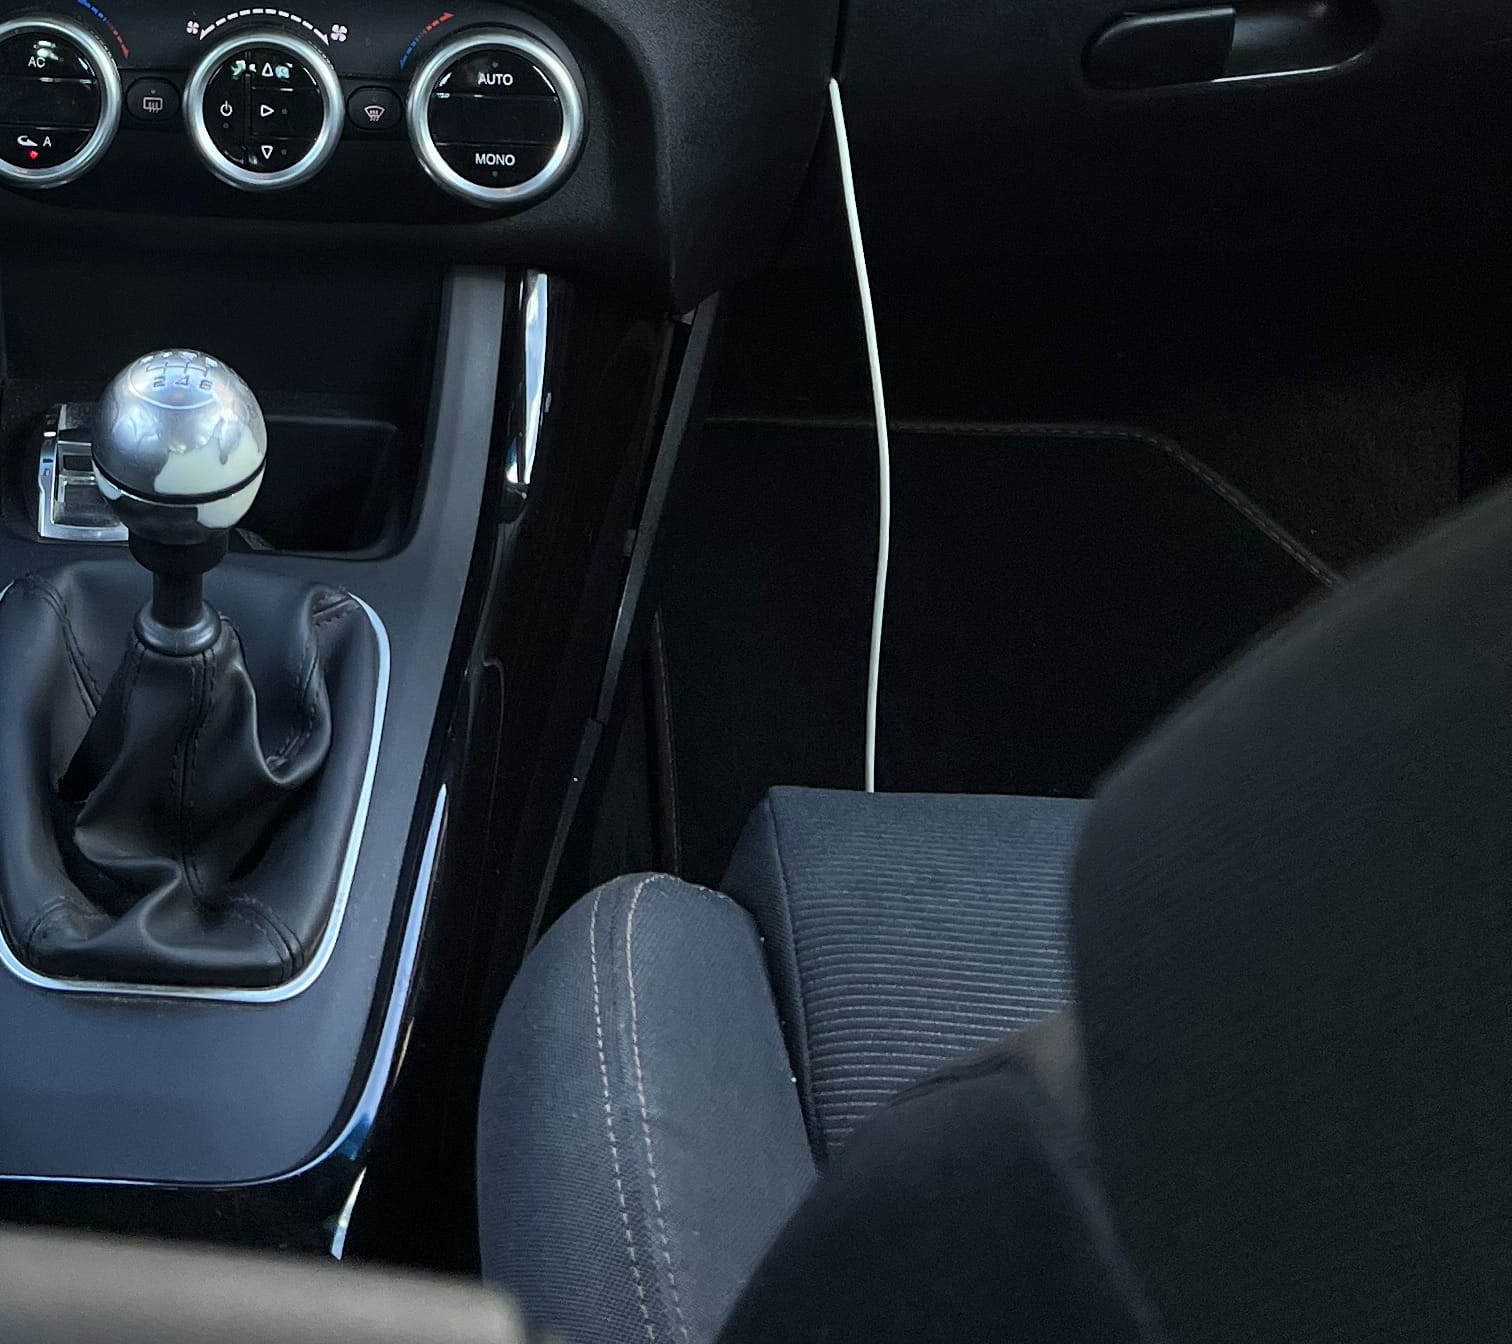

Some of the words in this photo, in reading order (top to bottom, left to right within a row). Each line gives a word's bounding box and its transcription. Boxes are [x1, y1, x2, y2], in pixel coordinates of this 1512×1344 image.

[28, 56, 46, 68] AC
[477, 72, 514, 86] AUTO
[42, 136, 52, 147] A
[475, 153, 516, 166] MONO
[153, 375, 166, 388] 2
[174, 375, 190, 387] 4
[199, 379, 213, 391] 6
